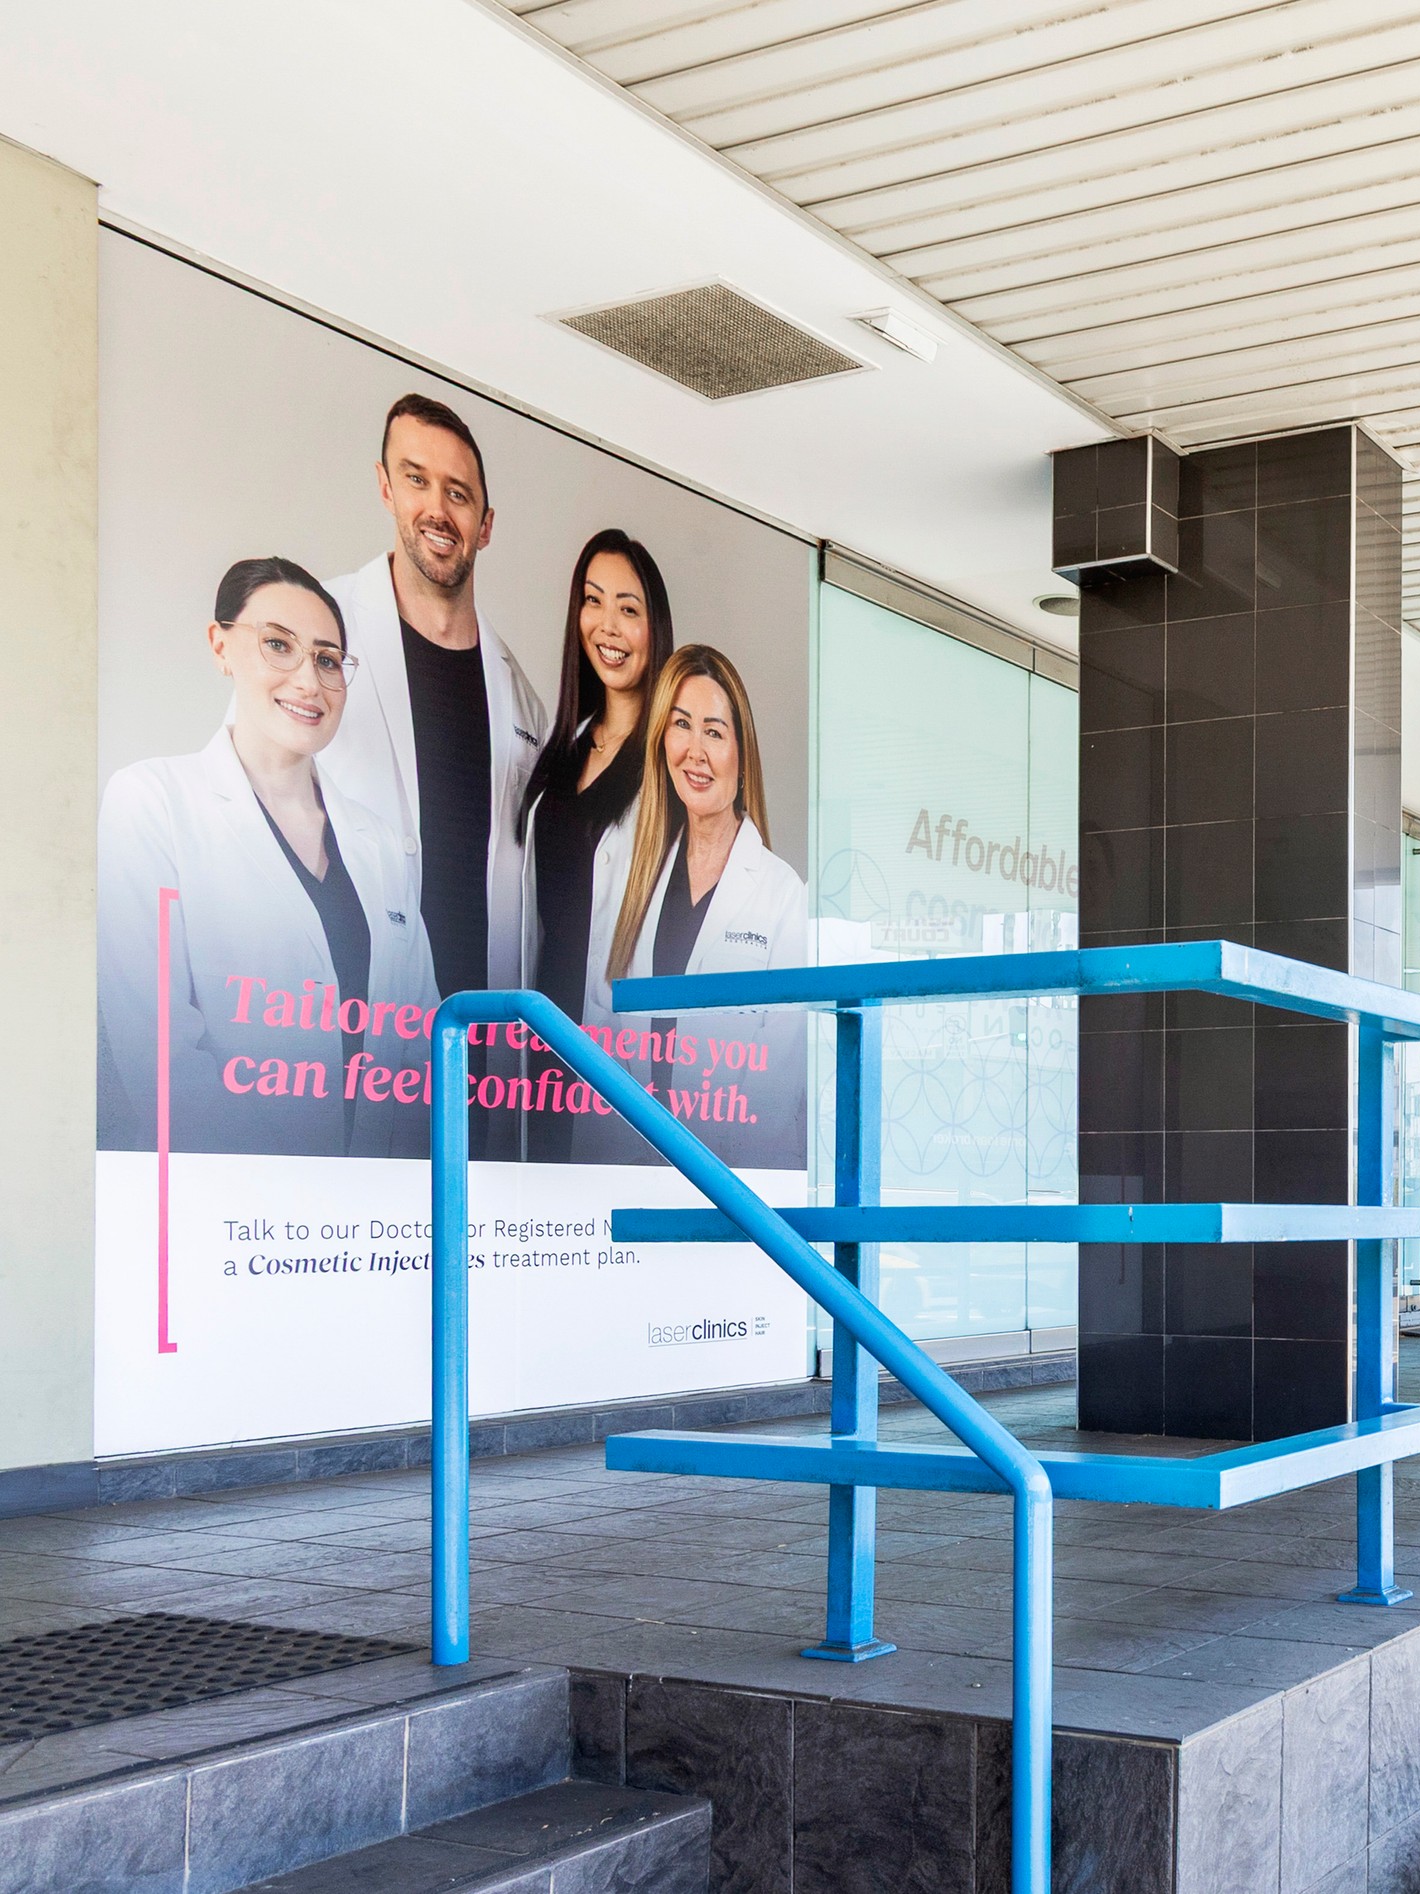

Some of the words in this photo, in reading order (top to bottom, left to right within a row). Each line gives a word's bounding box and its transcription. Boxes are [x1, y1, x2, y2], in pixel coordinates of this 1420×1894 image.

[905, 808, 1079, 898] Affordable
[702, 1038, 769, 1077] you
[223, 1056, 329, 1098] can
[667, 1079, 758, 1124] with.
[223, 1218, 275, 1241] Talk
[284, 1221, 310, 1240] to
[320, 1224, 360, 1240] our
[370, 1220, 433, 1239] Docto
[494, 1218, 595, 1243] Registered
[223, 1260, 237, 1276] a
[248, 1251, 362, 1276] Cosmetic
[493, 1249, 590, 1268] treatment
[598, 1246, 640, 1270] plan.
[647, 1318, 748, 1345] laserclinics
